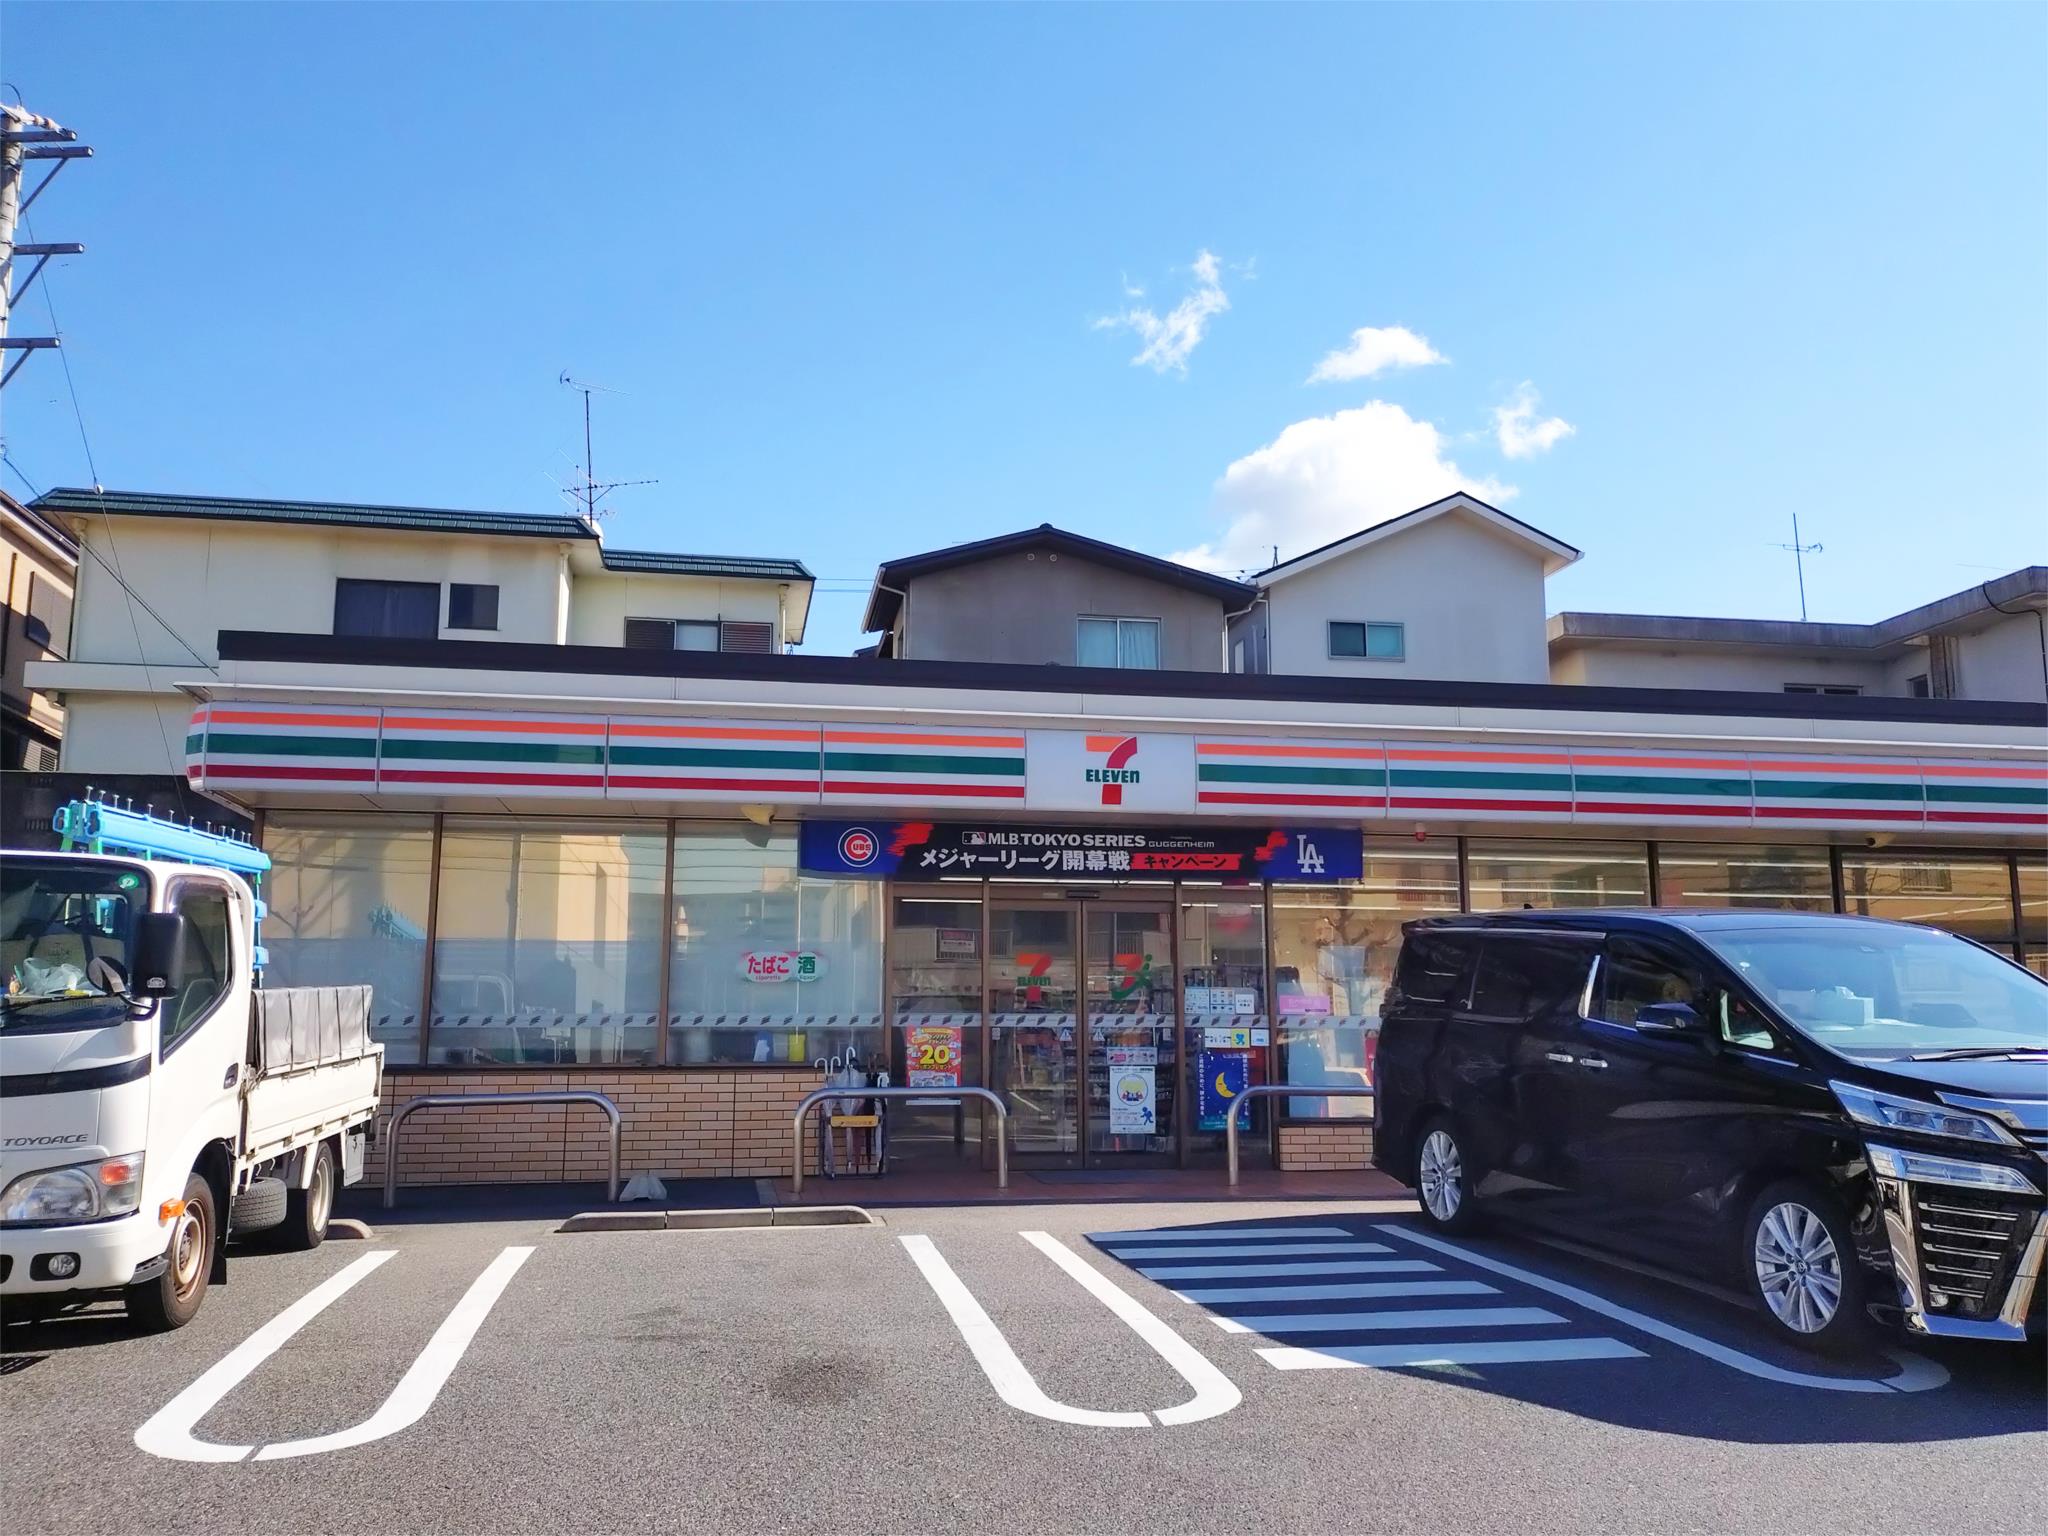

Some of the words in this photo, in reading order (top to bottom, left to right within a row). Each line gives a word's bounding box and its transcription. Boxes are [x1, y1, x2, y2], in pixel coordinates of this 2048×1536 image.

[988, 832, 1019, 846] MLB
[1020, 833, 1081, 847] TOKYO
[1082, 834, 1146, 847] SERIES
[1148, 840, 1215, 848] GUGGENHEIM
[919, 848, 1131, 872] メジャーリーグ開幕戦
[1143, 855, 1227, 869] キャンペーン
[1296, 834, 1325, 874] LA
[747, 955, 790, 974] たばこ
[797, 955, 816, 974] 酒
[920, 1044, 950, 1065] 20
[3, 1133, 89, 1147] TOYOACE
